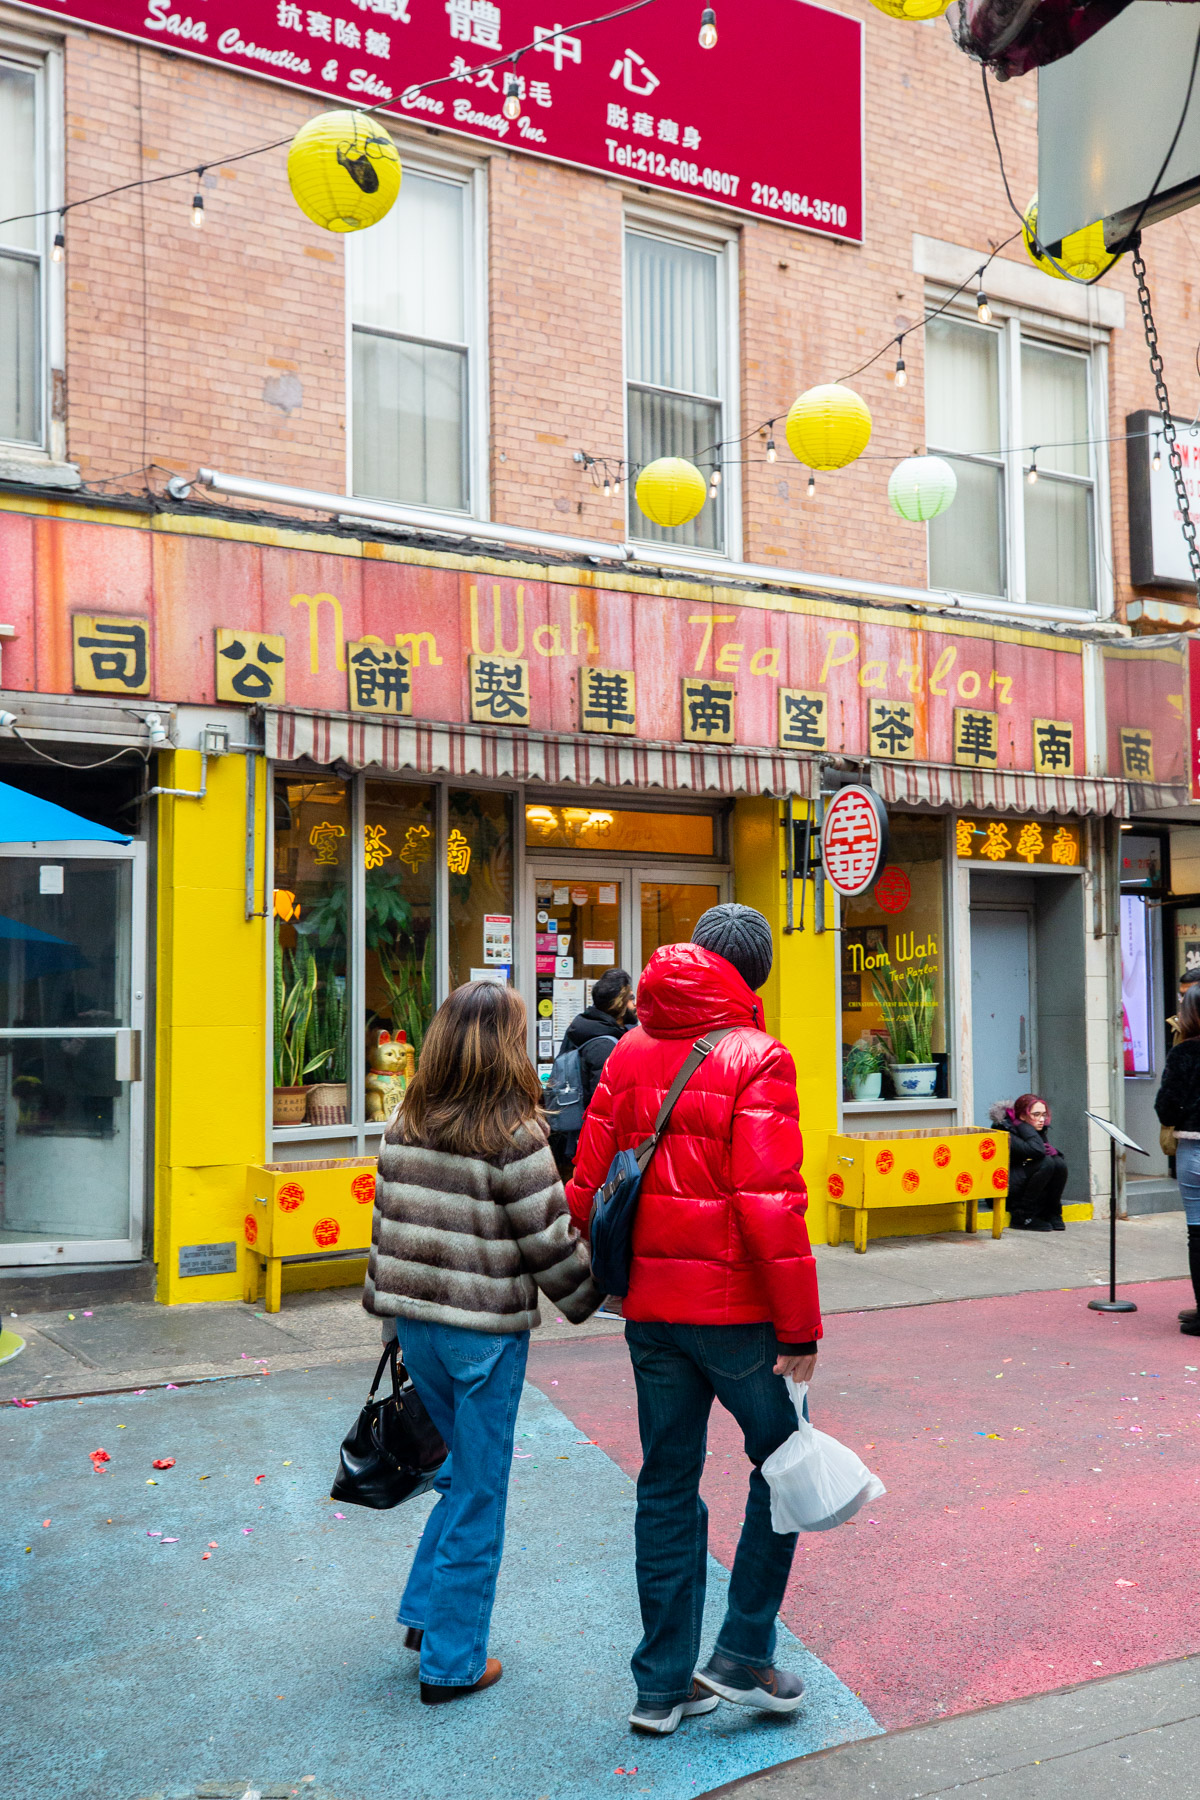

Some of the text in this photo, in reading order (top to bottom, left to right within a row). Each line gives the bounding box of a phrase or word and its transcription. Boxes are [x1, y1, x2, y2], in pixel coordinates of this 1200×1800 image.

[144, 0, 547, 143] Sasa Cosmetics & Skin Care Beauty Inc.
[605, 139, 848, 228] Tel:212-608-0907 212-964-3510
[470, 584, 599, 659] Wah
[819, 631, 1013, 705] Parlor
[847, 930, 938, 973] Nom Wah
[906, 964, 938, 977] Parlor
